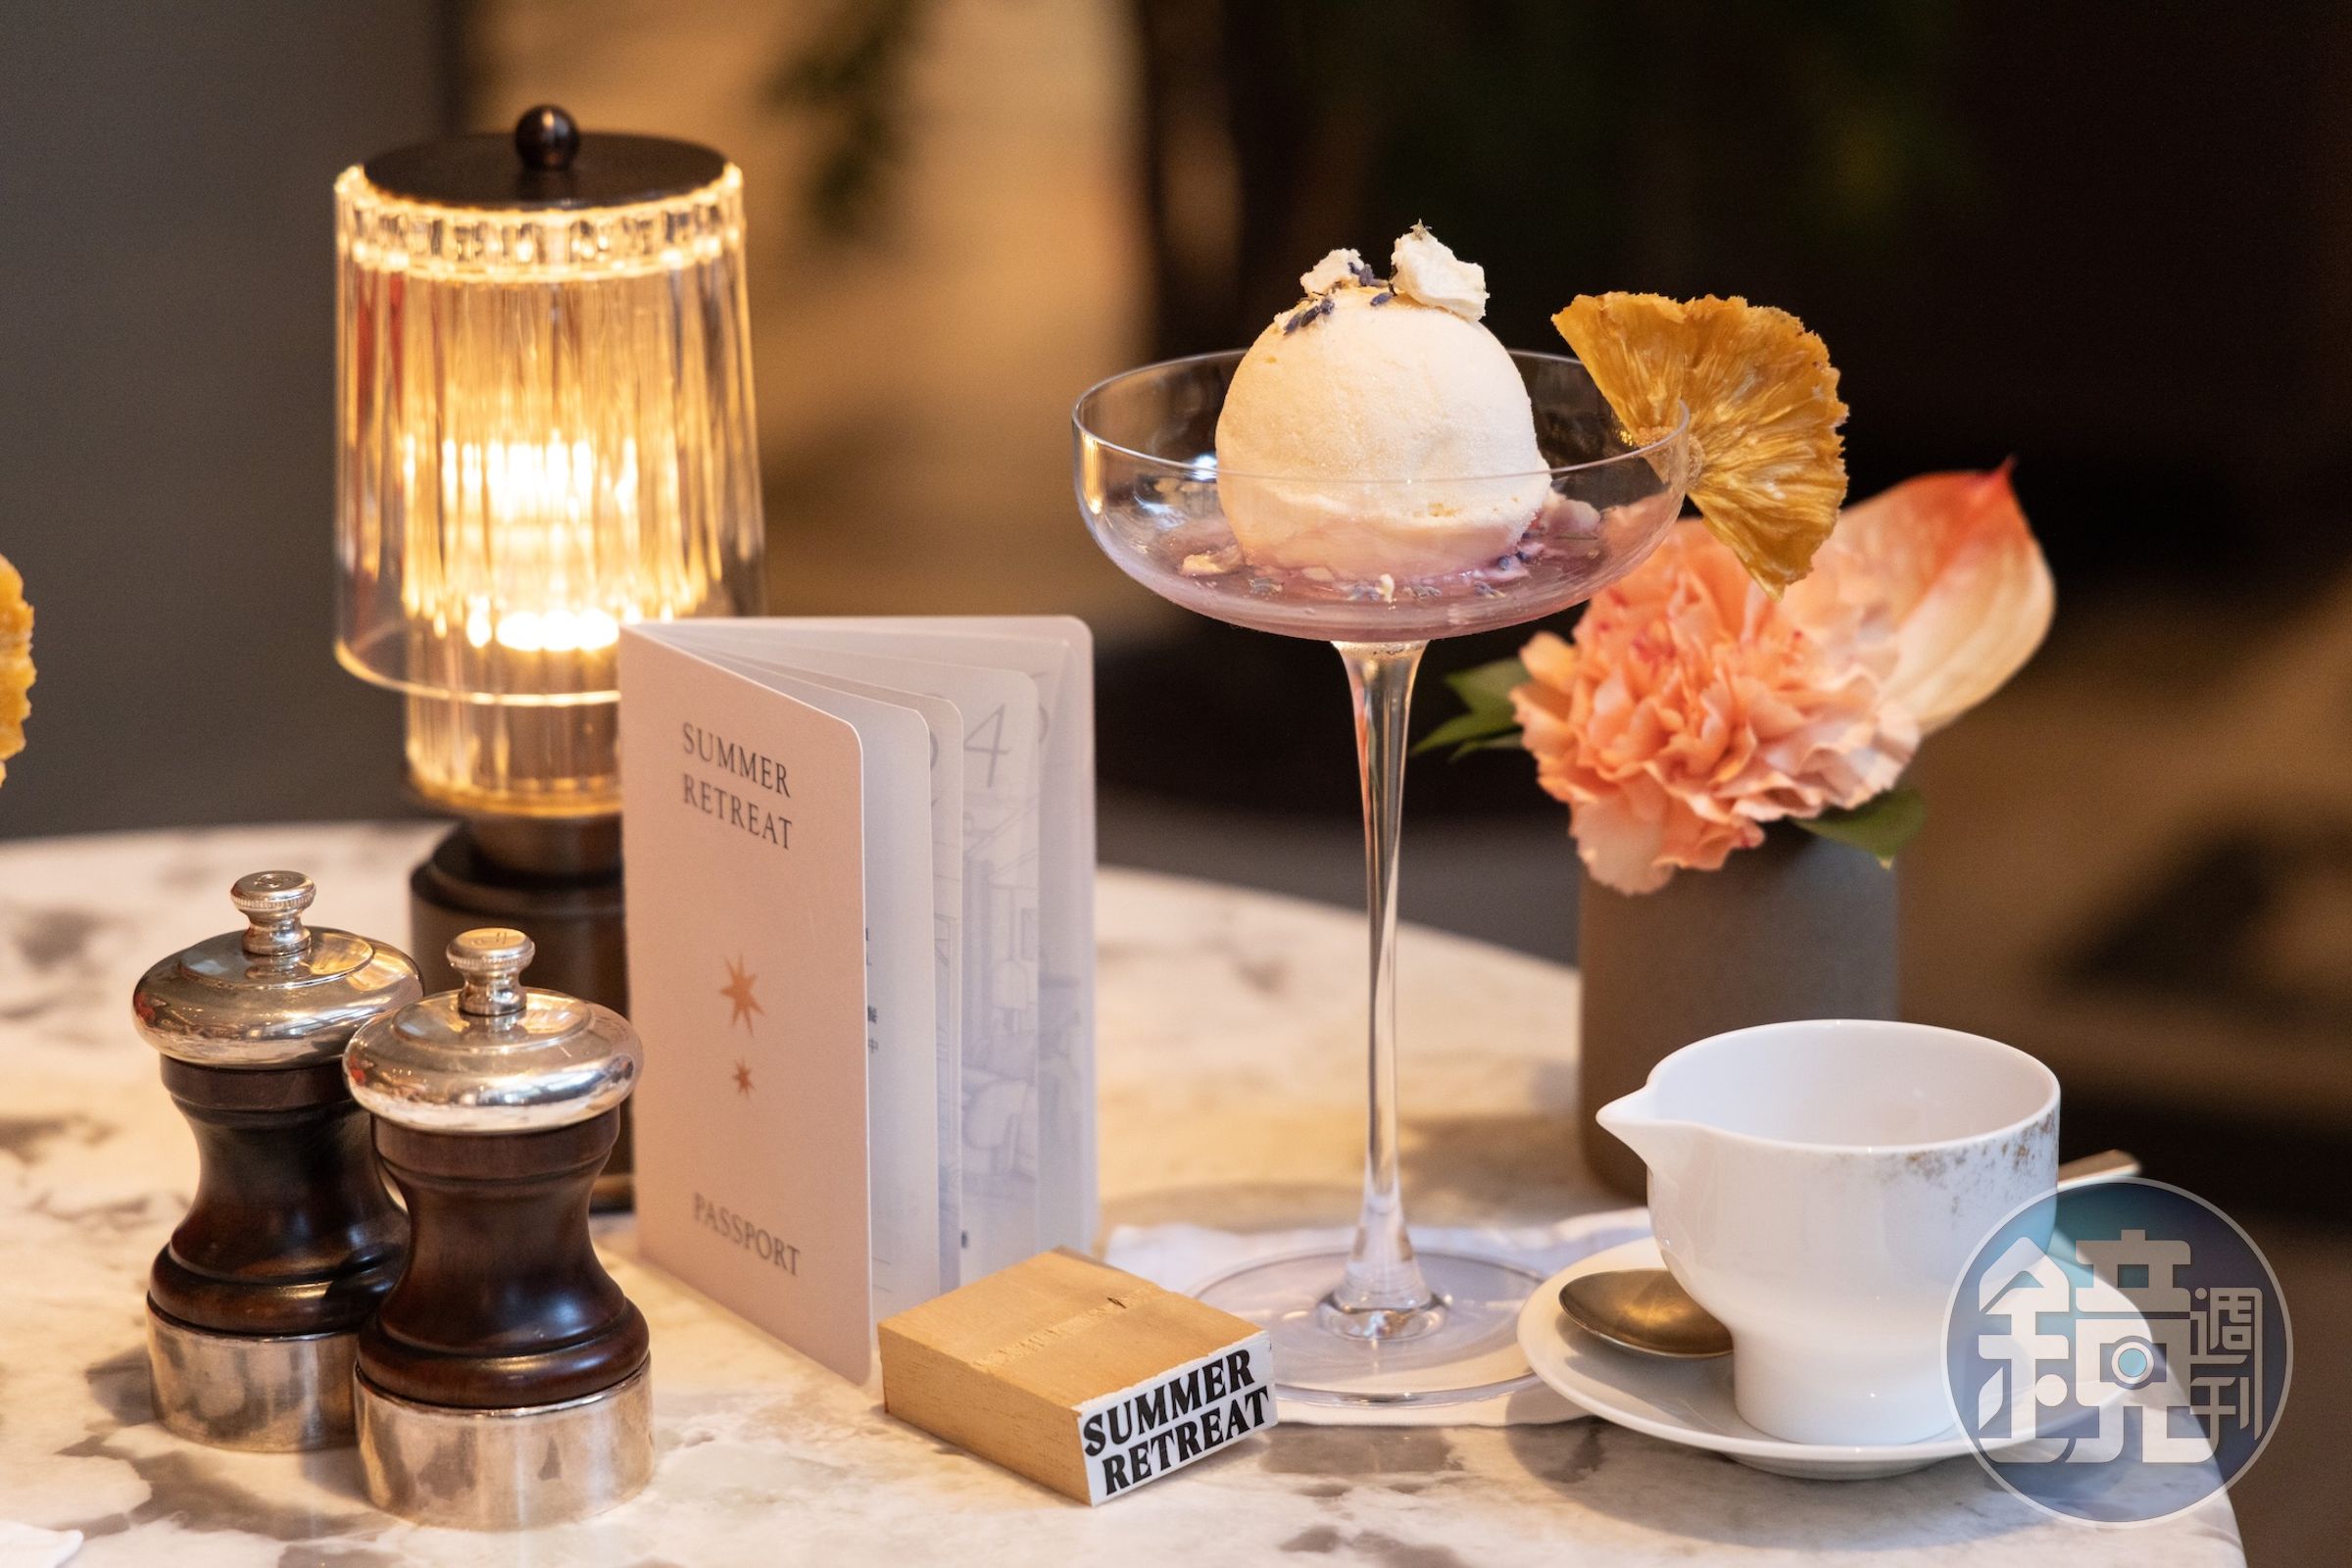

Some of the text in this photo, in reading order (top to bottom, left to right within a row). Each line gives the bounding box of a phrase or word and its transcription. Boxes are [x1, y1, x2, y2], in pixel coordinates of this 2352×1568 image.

[682, 722, 791, 798] SUMMER
[682, 773, 793, 850] RETREAT
[693, 1192, 801, 1276] PASSPORT
[1083, 1348, 1254, 1456] SUMMER
[1102, 1386, 1269, 1495] RETREAT
